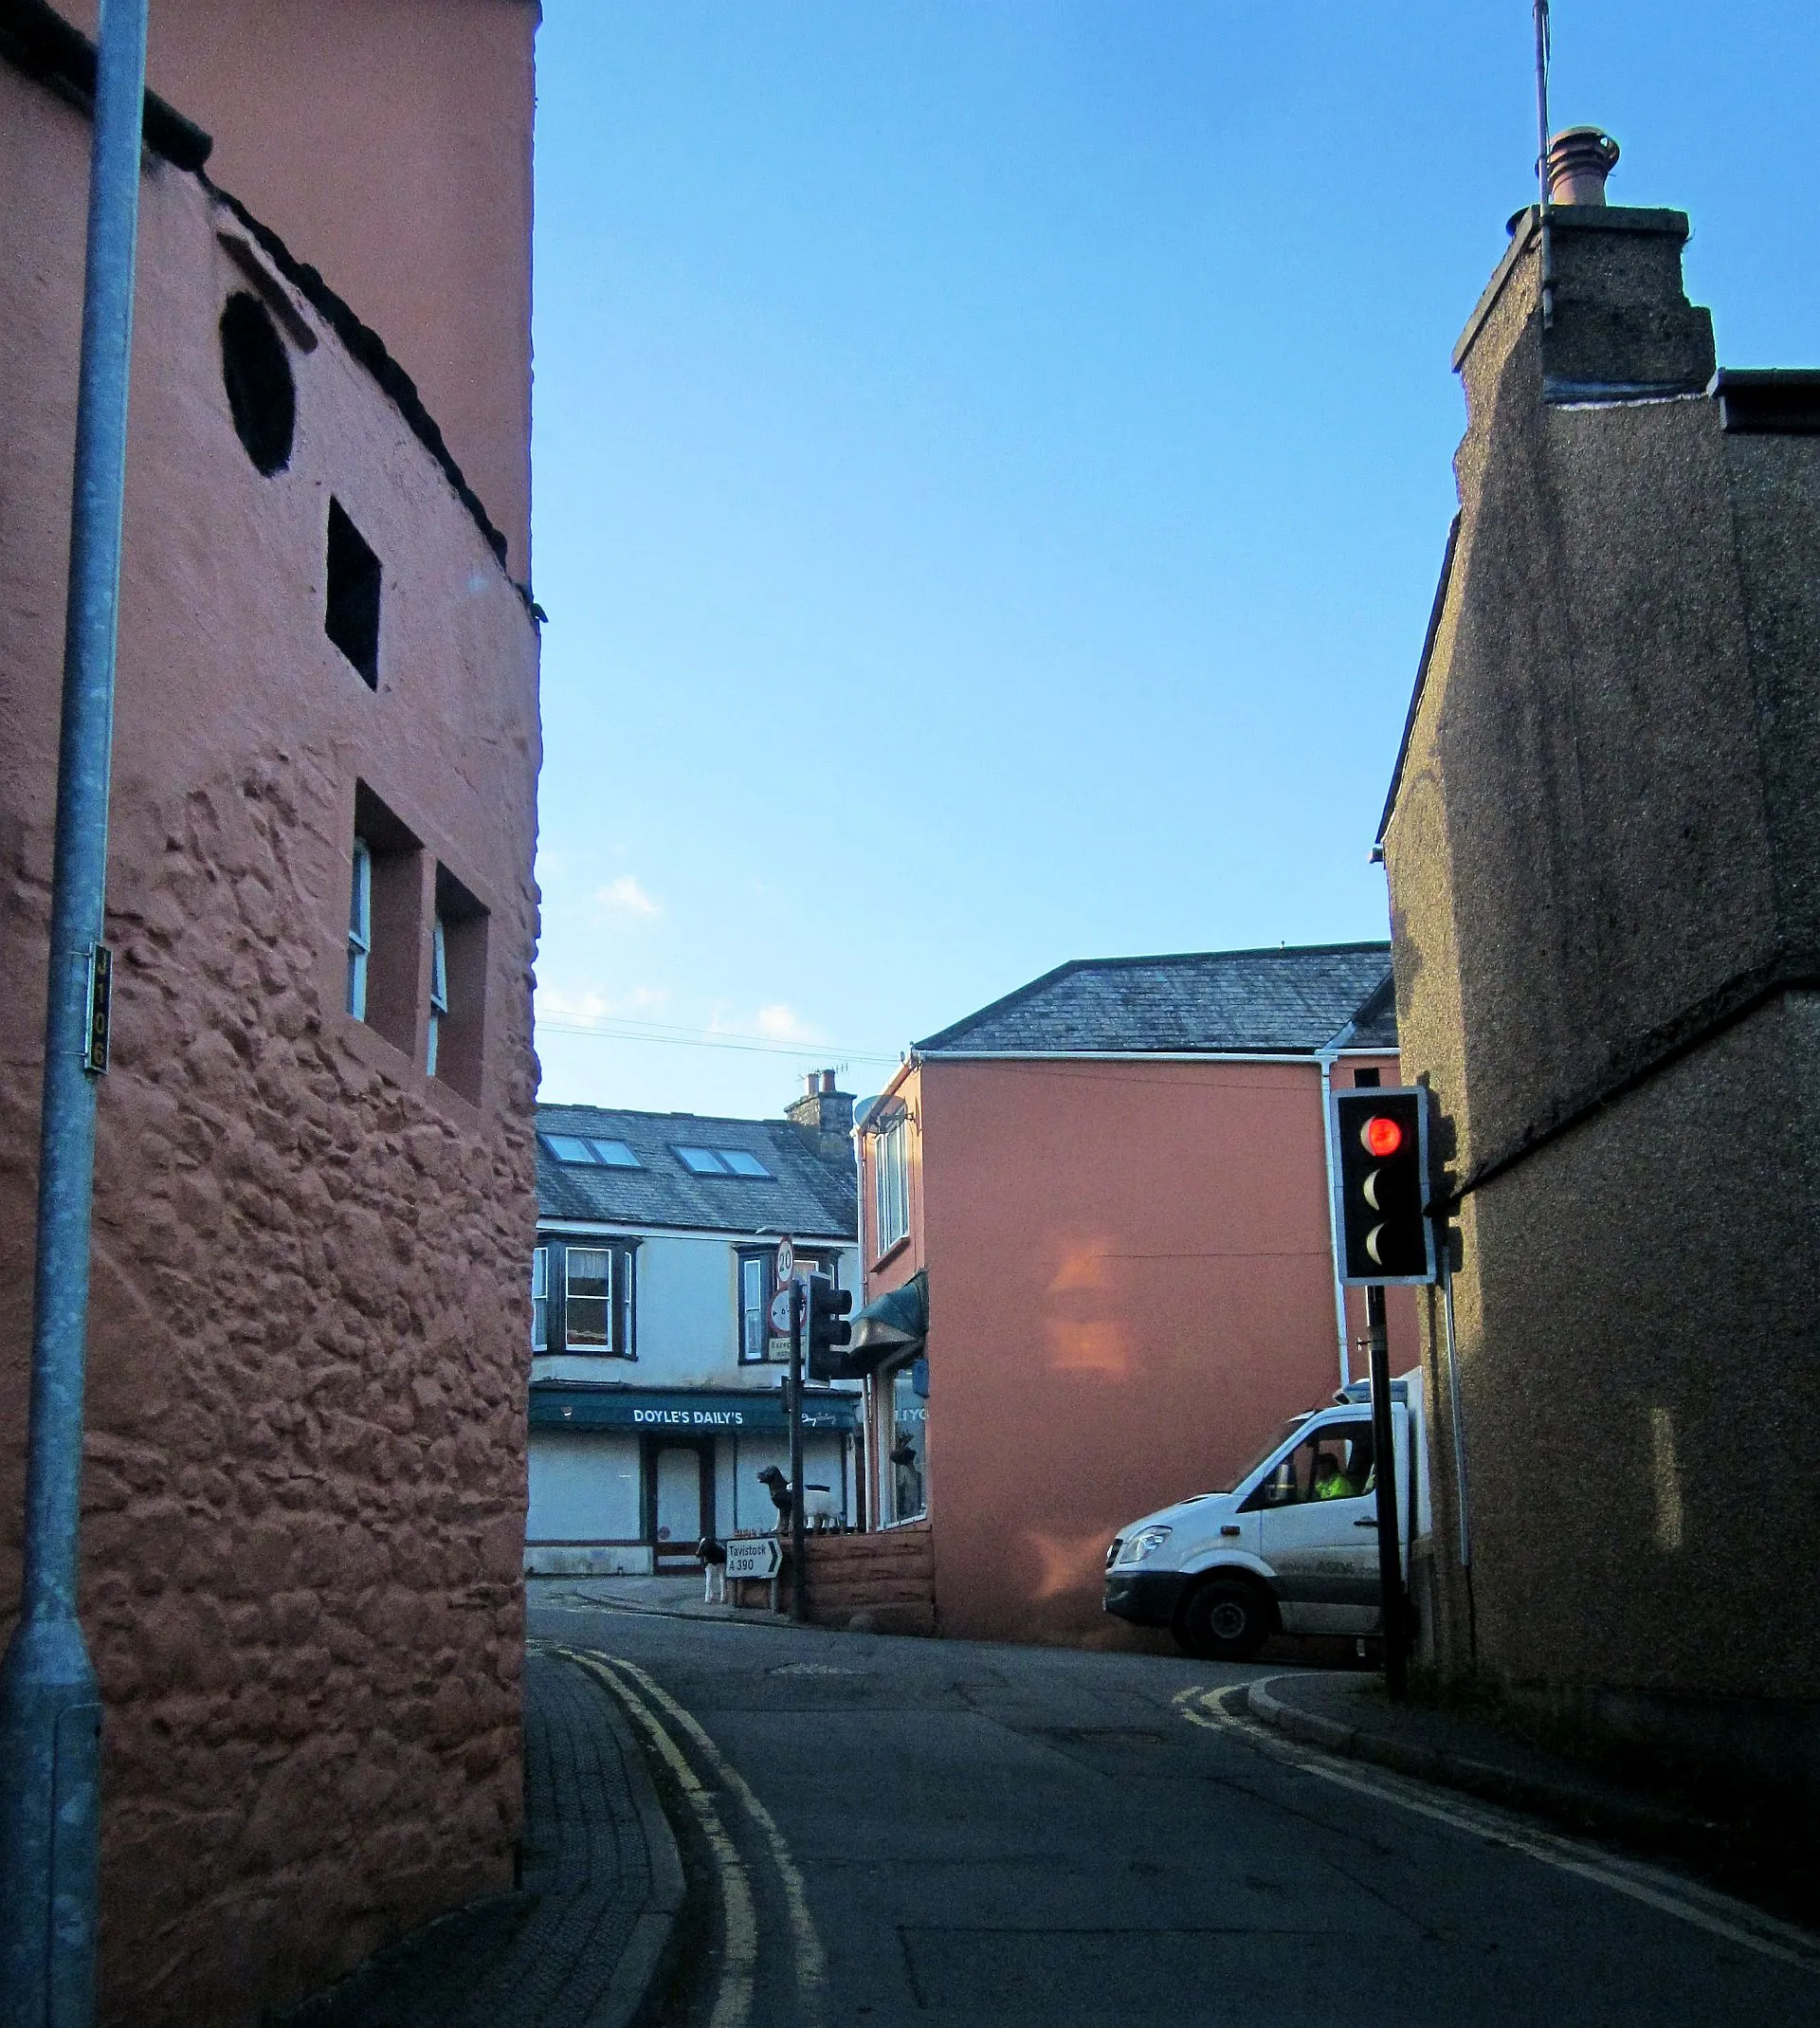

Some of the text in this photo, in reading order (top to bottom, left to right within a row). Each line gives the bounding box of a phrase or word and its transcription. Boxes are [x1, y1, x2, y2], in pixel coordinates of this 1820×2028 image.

[779, 1252, 792, 1272] 20
[633, 1409, 743, 1425] DOYLE'S DAILY'S
[729, 1544, 766, 1557] Tavistock
